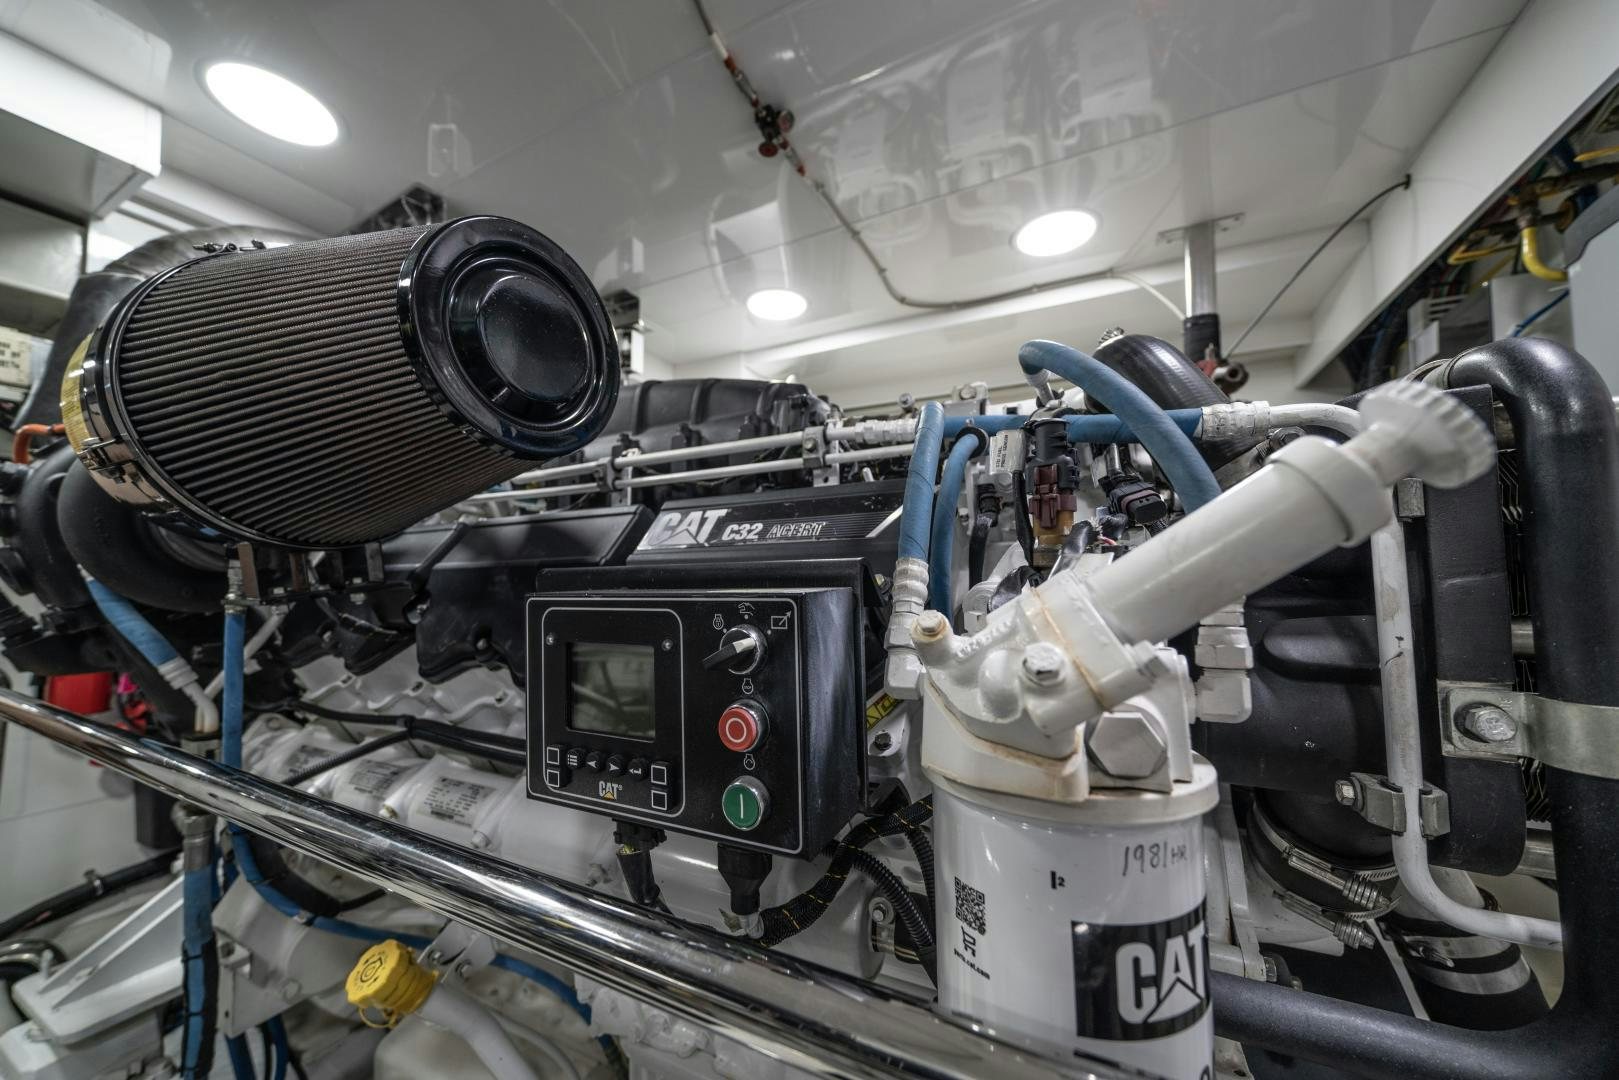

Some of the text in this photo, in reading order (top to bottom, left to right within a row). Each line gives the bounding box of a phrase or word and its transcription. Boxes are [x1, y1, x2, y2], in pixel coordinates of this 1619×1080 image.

[648, 509, 824, 546] CAT C32 ACERT
[1115, 920, 1205, 1024] CAT
